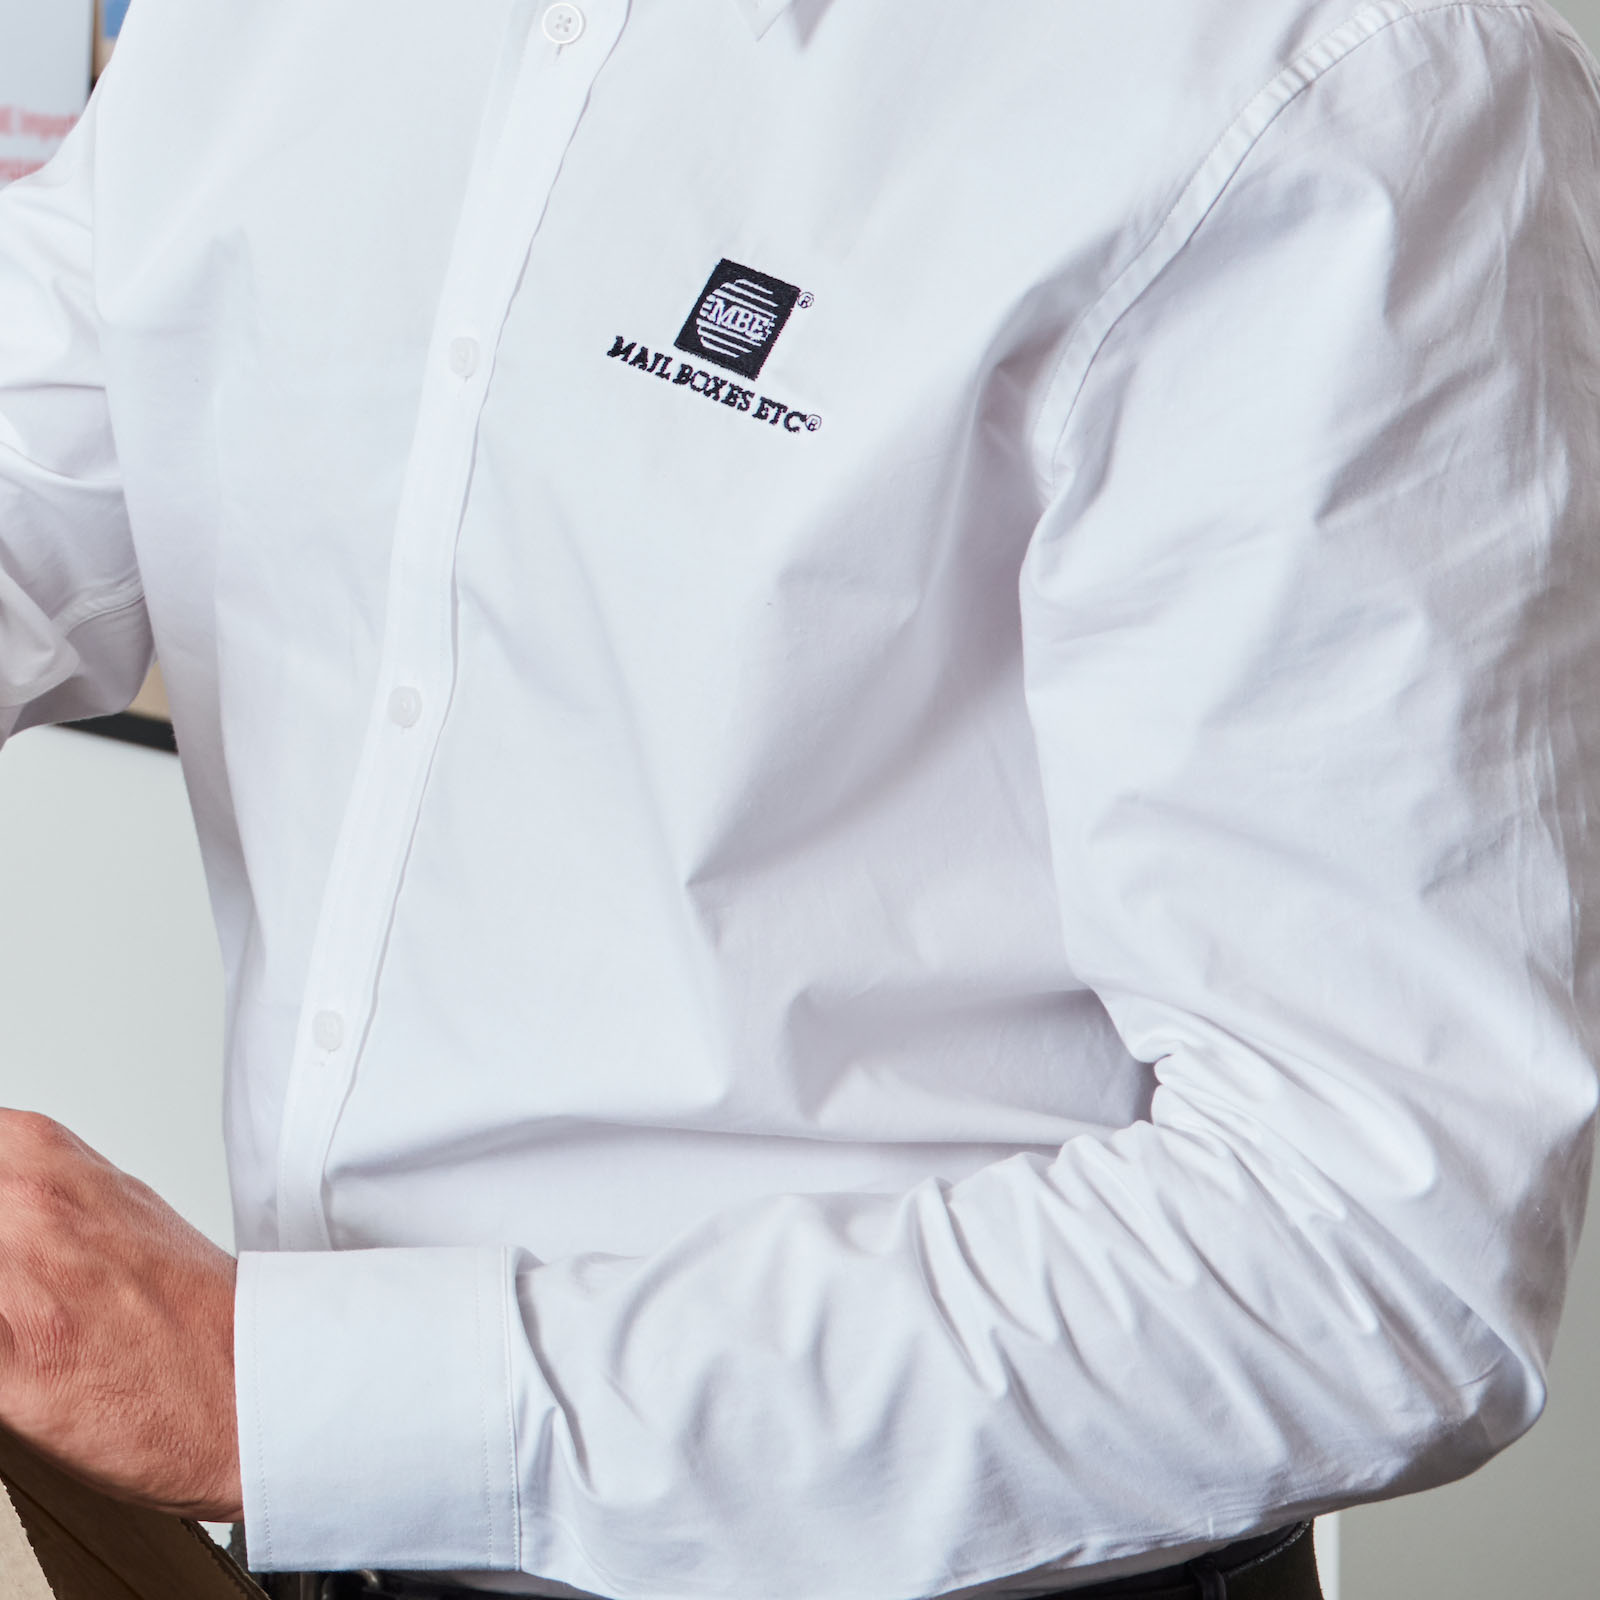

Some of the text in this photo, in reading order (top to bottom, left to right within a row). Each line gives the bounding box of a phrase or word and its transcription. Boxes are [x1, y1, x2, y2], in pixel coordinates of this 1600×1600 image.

[707, 297, 776, 341] MBE
[606, 335, 672, 382] MAIL
[672, 363, 756, 412] BOXES
